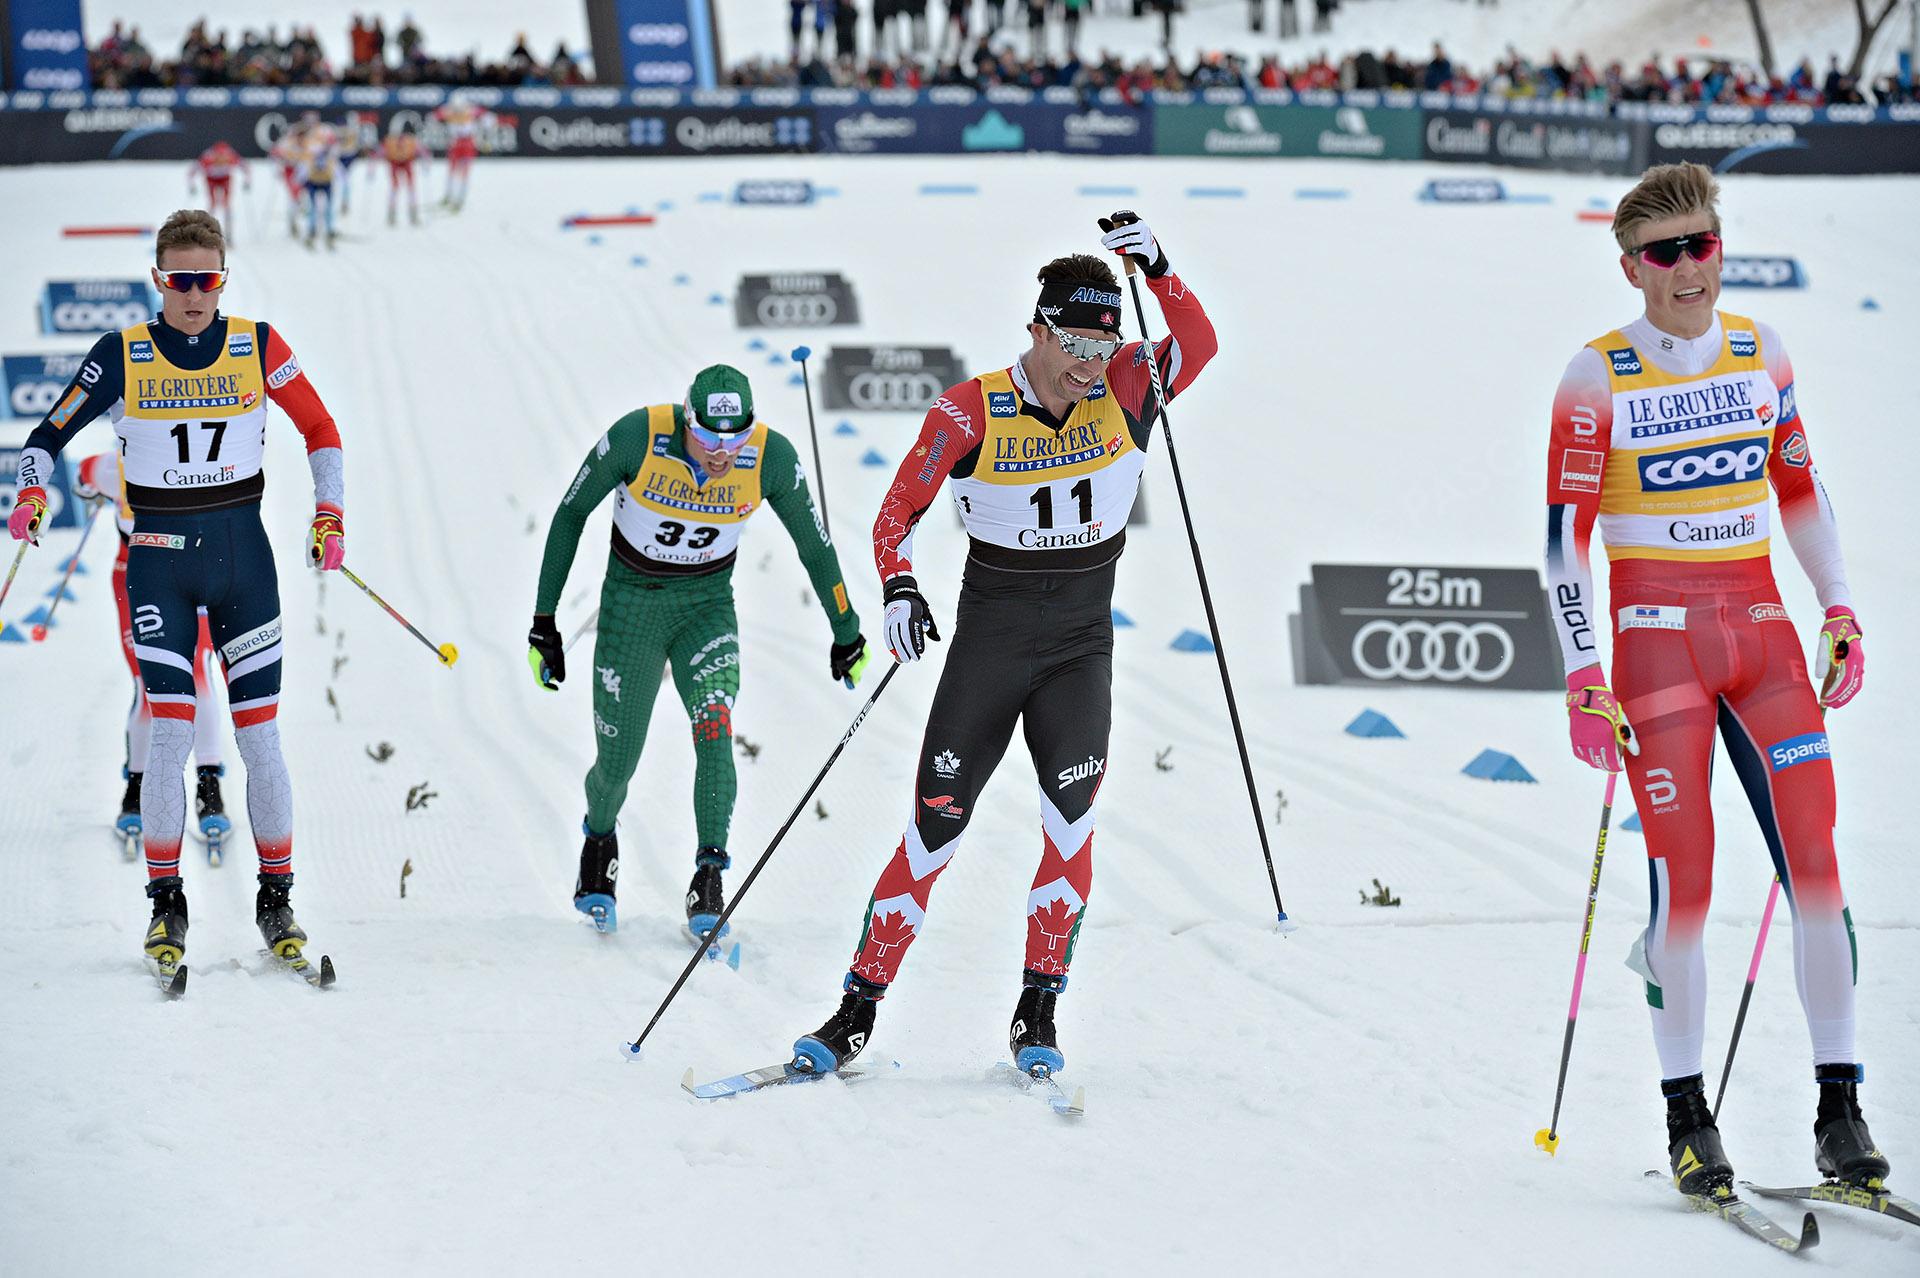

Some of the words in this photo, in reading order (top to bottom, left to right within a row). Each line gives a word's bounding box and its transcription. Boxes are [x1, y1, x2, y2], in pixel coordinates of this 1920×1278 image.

[1721, 260, 1793, 286] oop
[54, 302, 149, 329] coop
[130, 352, 154, 360] coop
[230, 344, 252, 354] coop
[1731, 343, 1757, 354] coop
[1613, 361, 1640, 371] coop
[138, 378, 156, 399] LE
[161, 373, 239, 398] GRUYÈRE
[141, 397, 236, 409] SWITZERLAND
[991, 405, 1016, 414] coop
[1628, 399, 1655, 424] LE
[1659, 381, 1751, 420] GRUYÈRE
[1637, 411, 1751, 437] SWITZERLAND
[170, 420, 227, 463] 17
[995, 437, 1017, 459] LE
[1022, 420, 1103, 458] GRUYÈRE
[735, 459, 756, 467] coop
[918, 430, 949, 485] HAYWOOD
[999, 448, 1101, 471] SWITZERLAND
[1645, 445, 1767, 485] coop
[163, 466, 234, 486] Canada
[646, 472, 666, 493] LE
[668, 479, 736, 504] GRUYÈRE
[1563, 472, 1600, 483] VEIDEKKE
[646, 491, 731, 514] SWITZERLAND
[1029, 478, 1093, 529] 11
[129, 535, 169, 546] SPAR
[655, 521, 720, 549] 33
[1018, 525, 1101, 549] Canada
[1669, 514, 1755, 542] Canada
[644, 544, 711, 563] Canada
[1386, 568, 1482, 608] 25m
[1621, 619, 1684, 630] RGHATTEN
[226, 623, 282, 659] SpareBan
[693, 652, 738, 681] FALCO
[1058, 756, 1106, 790] swix
